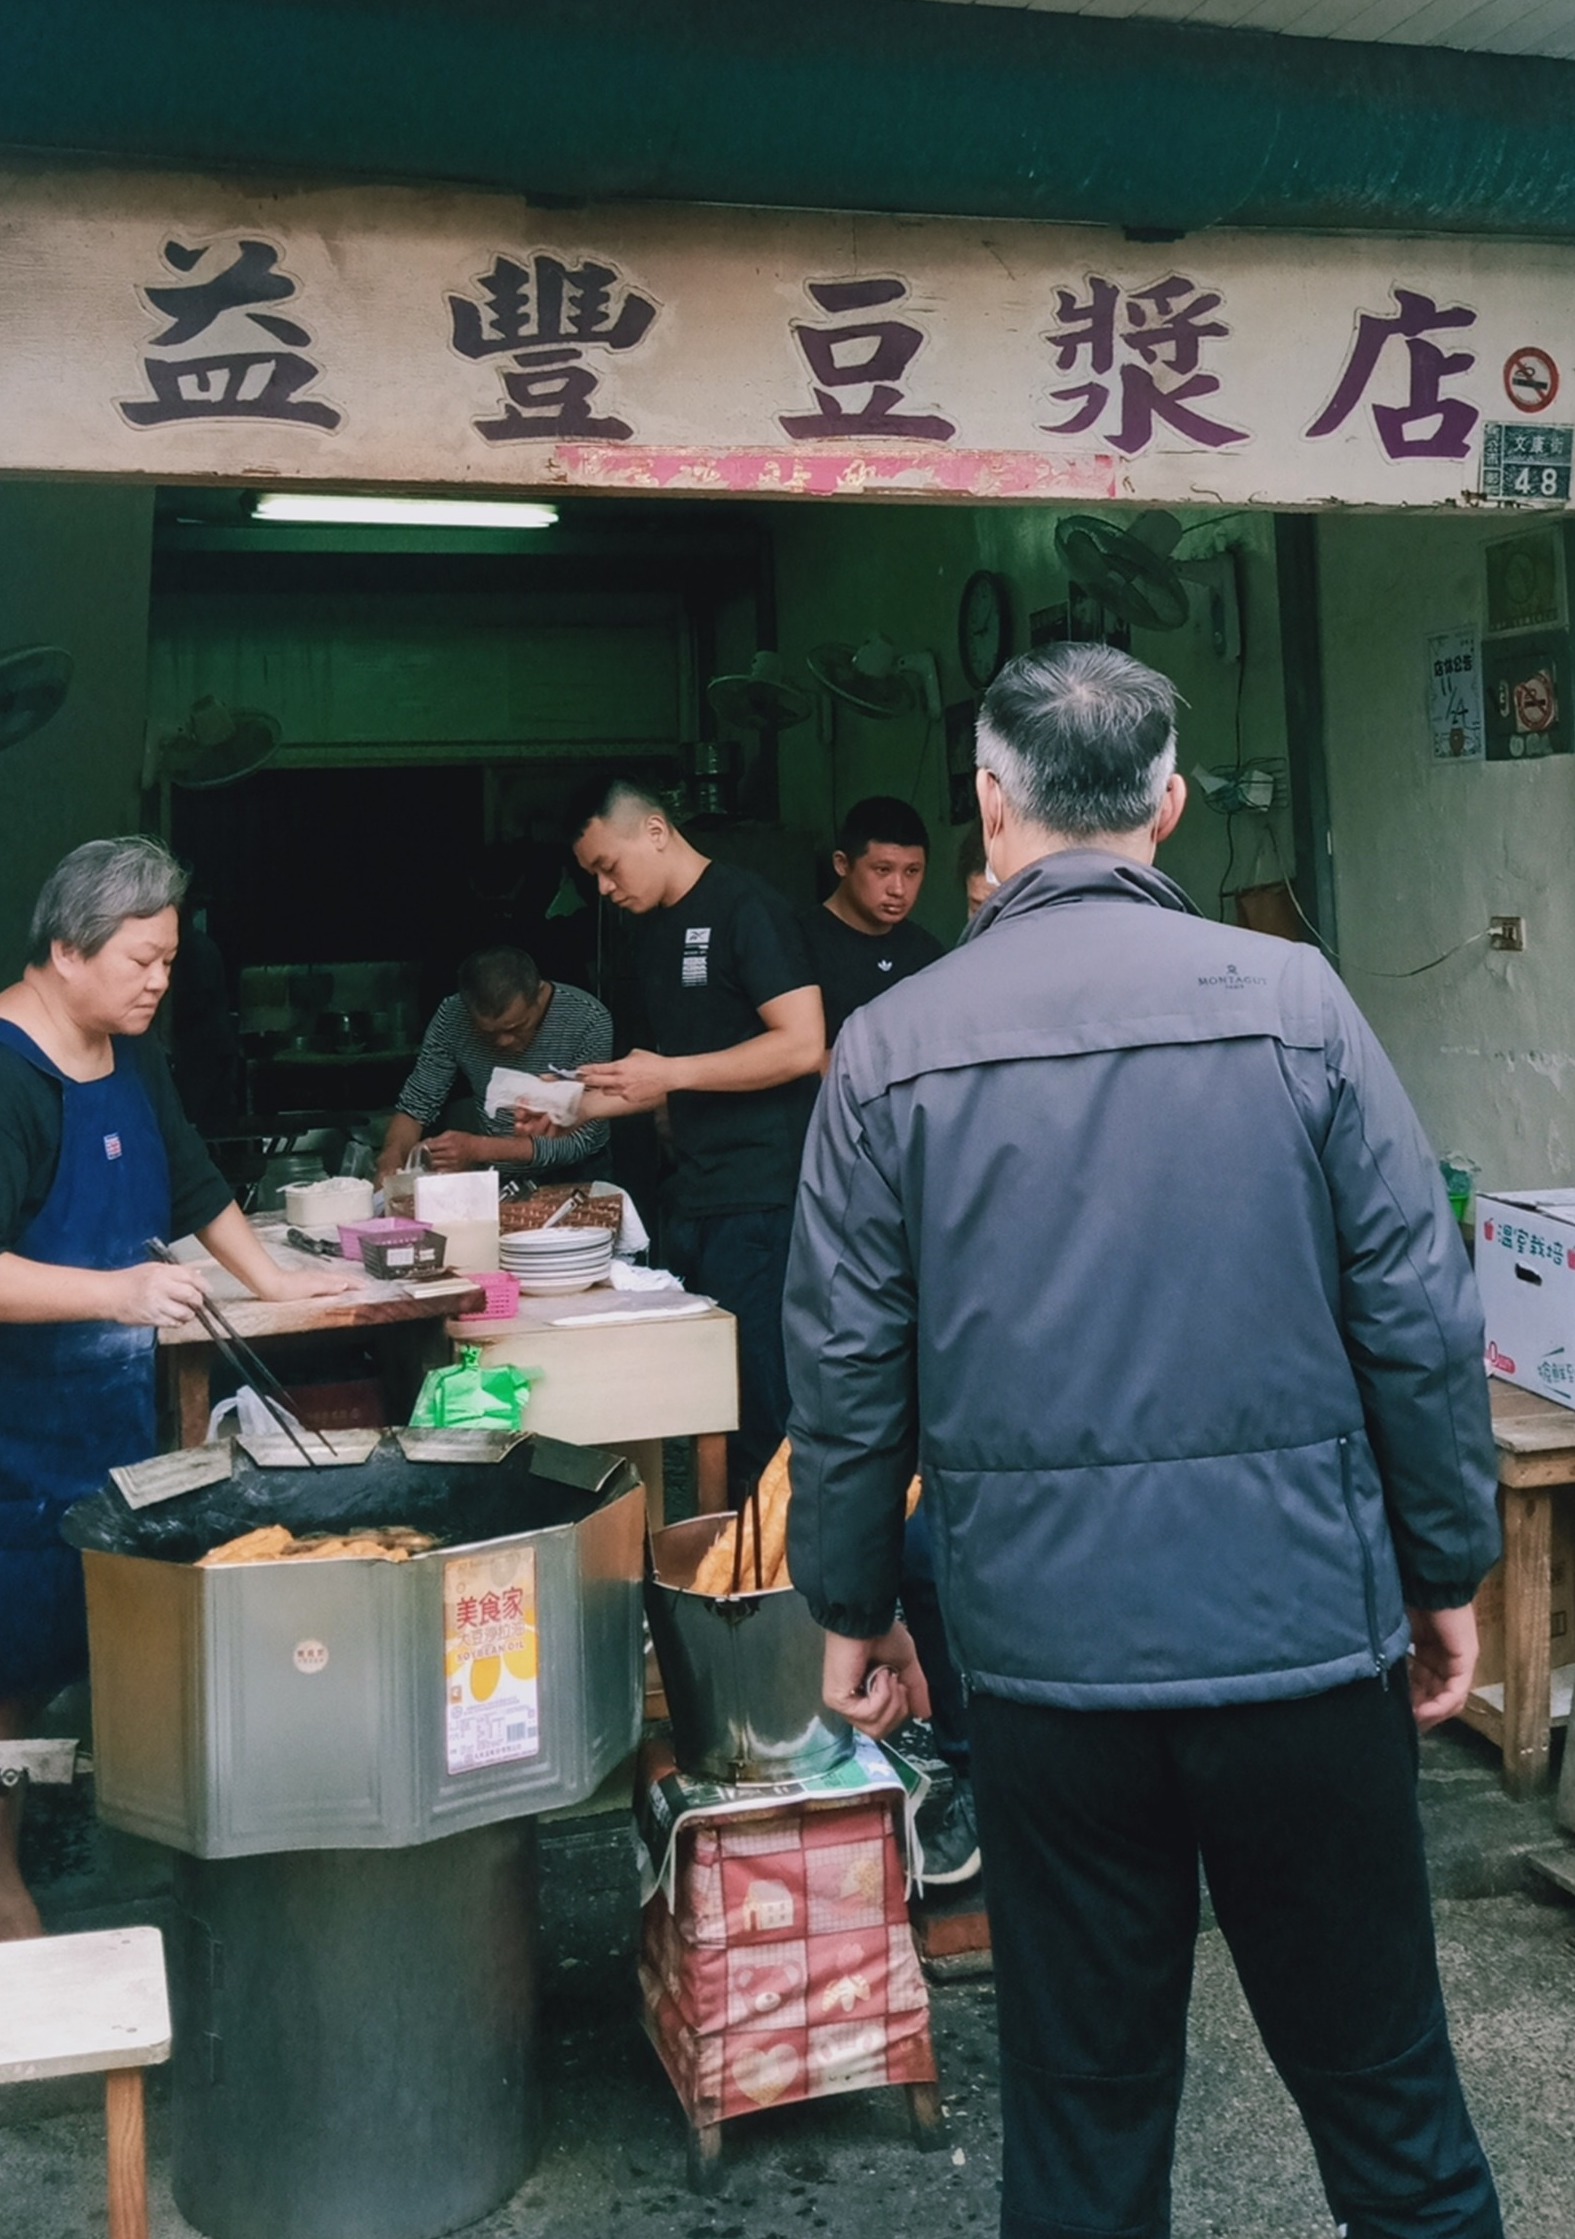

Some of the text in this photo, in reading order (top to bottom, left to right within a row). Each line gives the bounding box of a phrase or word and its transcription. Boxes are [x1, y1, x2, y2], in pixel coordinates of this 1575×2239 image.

[119, 240, 1480, 459] 益豐豆漿店
[1514, 467, 1558, 496] 48
[1198, 976, 1268, 986] MONTAGUT
[456, 1586, 524, 1630] 美食家
[457, 1641, 525, 1662] SOYBEAN OIL
